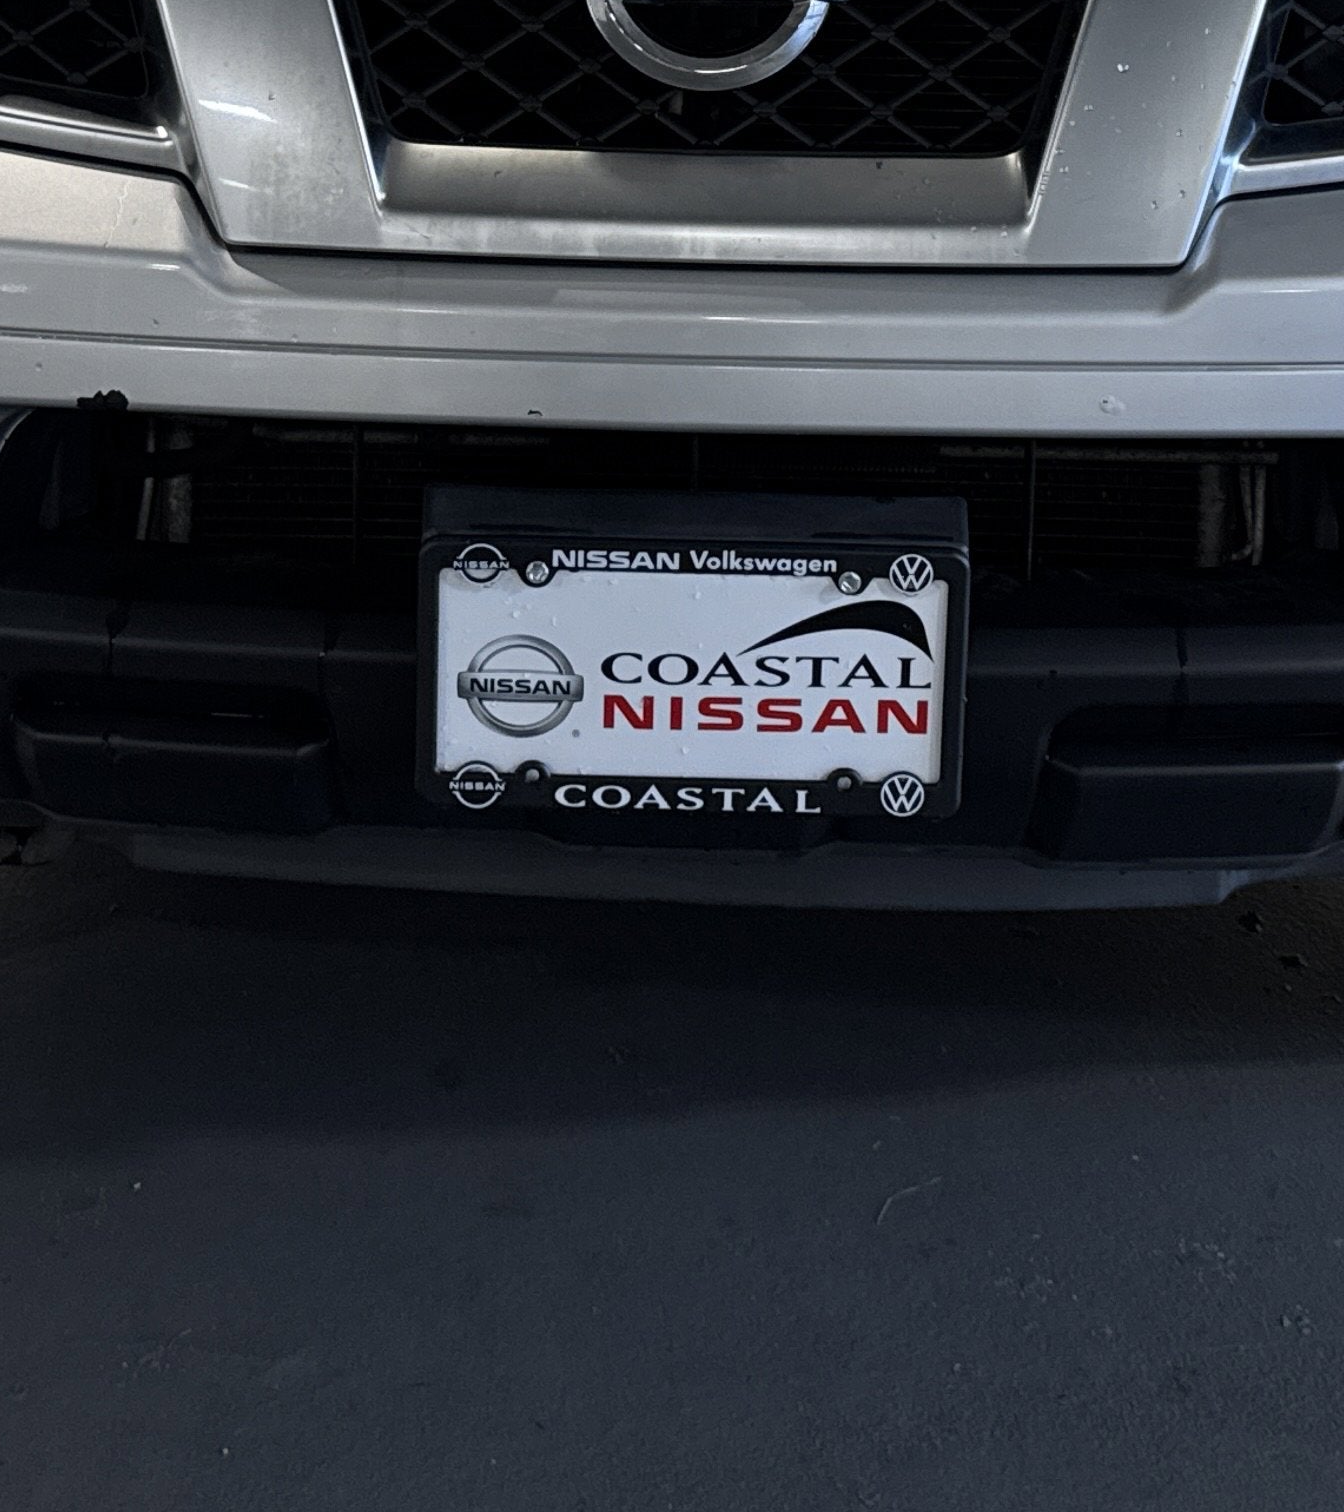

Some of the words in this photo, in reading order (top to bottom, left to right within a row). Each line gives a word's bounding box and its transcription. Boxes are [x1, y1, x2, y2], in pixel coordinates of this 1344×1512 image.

[453, 560, 510, 570] NISSAN
[552, 549, 681, 571] NISSAN
[690, 550, 838, 577] Volkswagen
[601, 651, 933, 690] COASTAL
[469, 676, 572, 697] NISSAN
[602, 694, 929, 735] NISSAN
[449, 781, 506, 792] NISSAN
[555, 784, 822, 815] COASTAL
